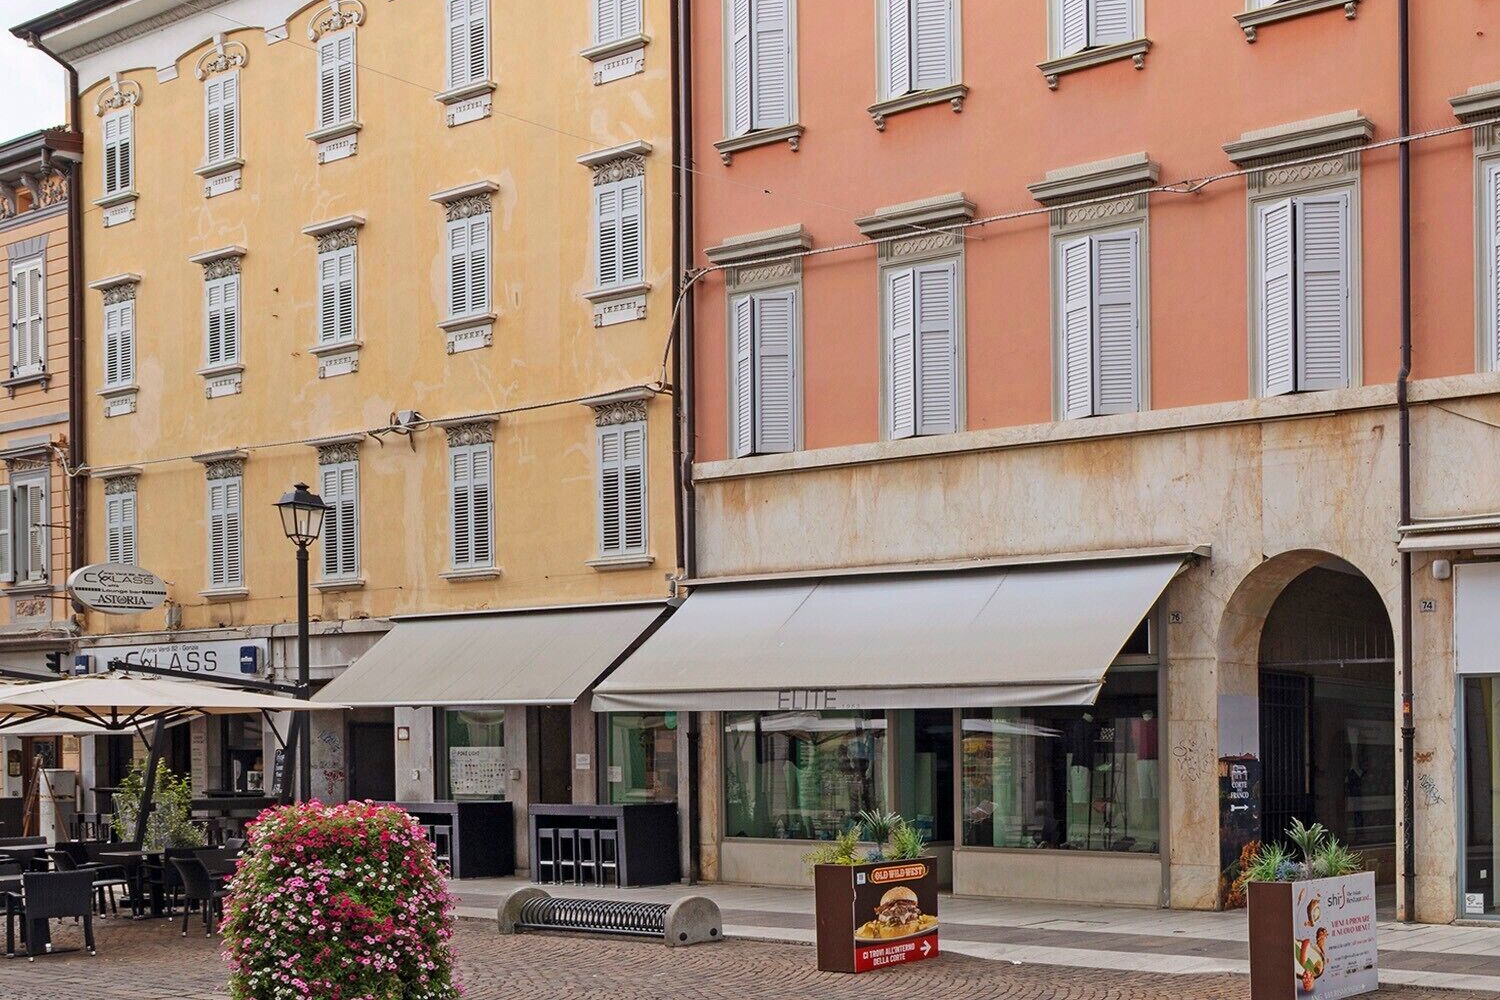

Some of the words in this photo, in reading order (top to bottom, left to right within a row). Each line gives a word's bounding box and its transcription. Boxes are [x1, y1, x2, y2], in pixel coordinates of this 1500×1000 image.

[98, 595, 147, 605] ASTORIA
[1422, 601, 1433, 609] 74
[778, 689, 837, 710] ELITE
[875, 870, 888, 880] OLD
[888, 868, 905, 879] WILD
[905, 866, 923, 877] WEST
[862, 951, 869, 960] CI
[869, 948, 885, 958] TROVI
[873, 956, 889, 966] DELLA
[890, 952, 906, 963] CORTE
